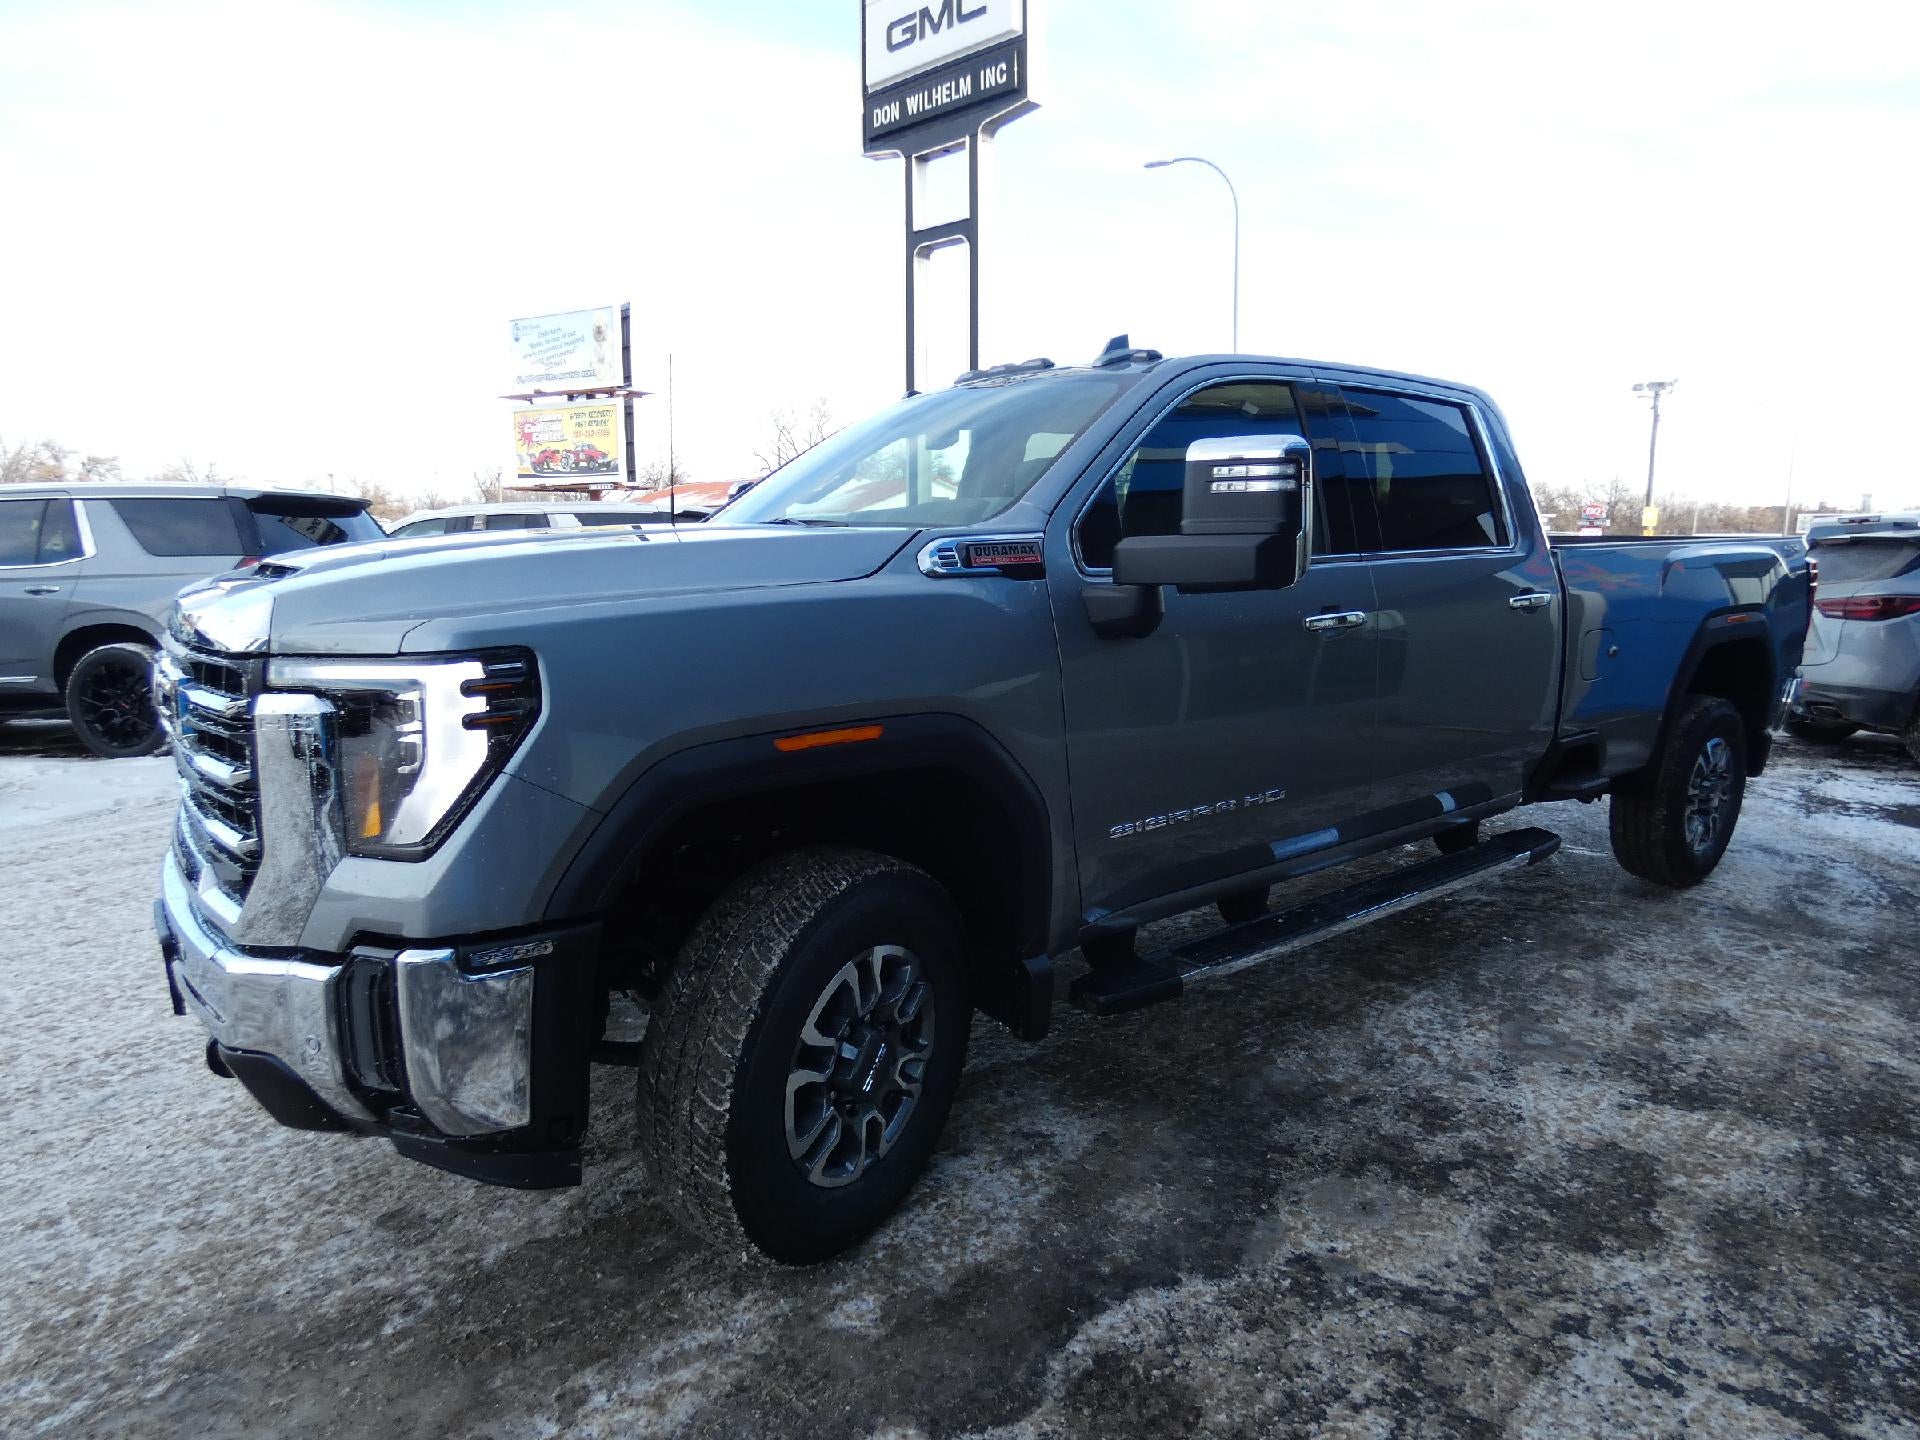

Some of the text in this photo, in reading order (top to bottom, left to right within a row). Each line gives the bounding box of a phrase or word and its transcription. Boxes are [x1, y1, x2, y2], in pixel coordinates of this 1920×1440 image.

[873, 62, 1007, 128] DON WILHELM INC
[974, 544, 1036, 557] DURAMAX
[1110, 788, 1287, 839] SIERRA HD
